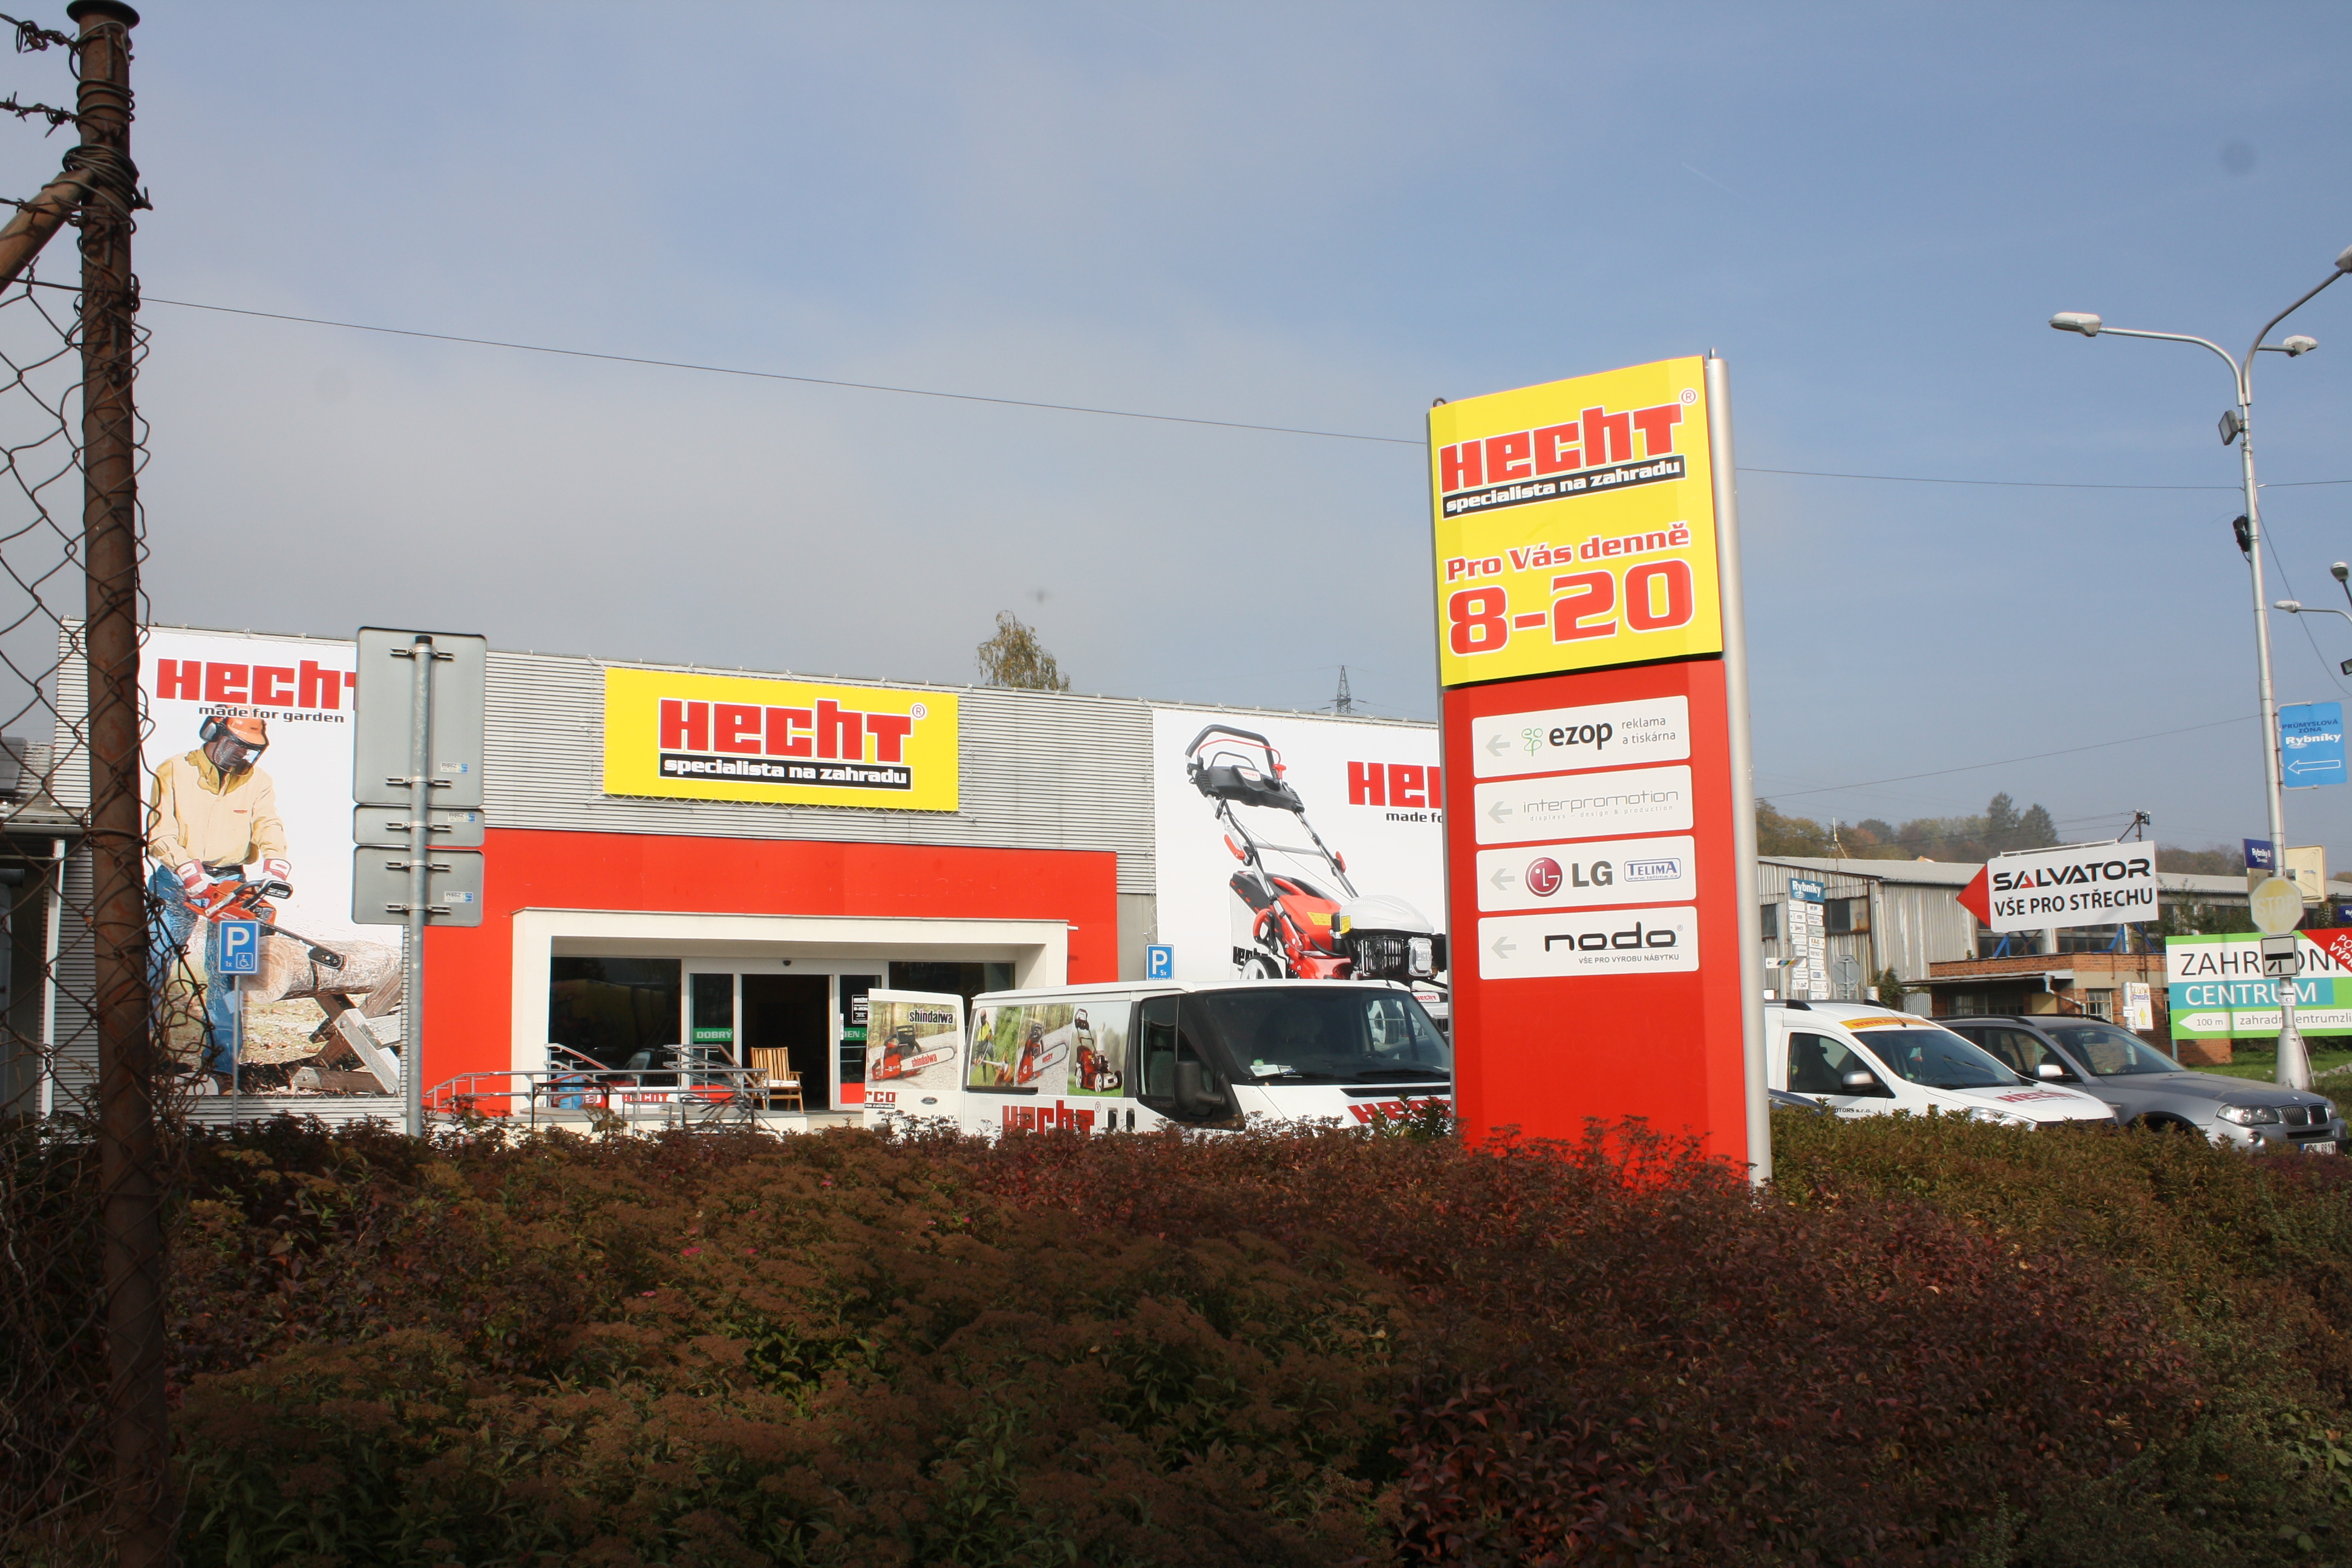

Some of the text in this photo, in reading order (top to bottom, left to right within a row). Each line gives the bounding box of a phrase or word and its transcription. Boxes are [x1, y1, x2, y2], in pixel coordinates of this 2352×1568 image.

[1446, 461, 1680, 512] specialista na zahradu
[1447, 522, 1690, 581] Pro Vás denně
[1449, 560, 1693, 655] 8-20
[156, 658, 356, 710] Hech
[199, 705, 345, 723] made for garden
[1621, 717, 1666, 730] reklama
[2282, 719, 2338, 729] PRŮMYSLOVÁ
[1549, 722, 1613, 751] ezop
[1622, 730, 1676, 745] a tiskárna
[2285, 733, 2341, 745] Rybníky
[664, 759, 907, 784] specialista na zahradu
[1523, 790, 1679, 813] interpromotion
[1386, 812, 1427, 822] made
[1530, 813, 1566, 822] displays
[1624, 805, 1673, 815] production
[1572, 861, 1613, 887] LG
[1993, 858, 2151, 892] SALVATOR
[1792, 880, 1821, 897] Rybníky
[1994, 887, 2152, 917] VŠE PRO STŘECHU
[2256, 895, 2296, 918] STOP
[227, 927, 250, 956] P
[1544, 921, 1676, 952] nodo
[2337, 935, 2352, 949] PO
[1152, 950, 1168, 975] P
[2180, 949, 2339, 976] ZAHRN
[909, 1010, 953, 1024] shindaiwa
[2240, 1013, 2352, 1025] zahradnentrumzli
[696, 1029, 733, 1039] DOBRÝ
[911, 1054, 937, 1068] shindaiwa
